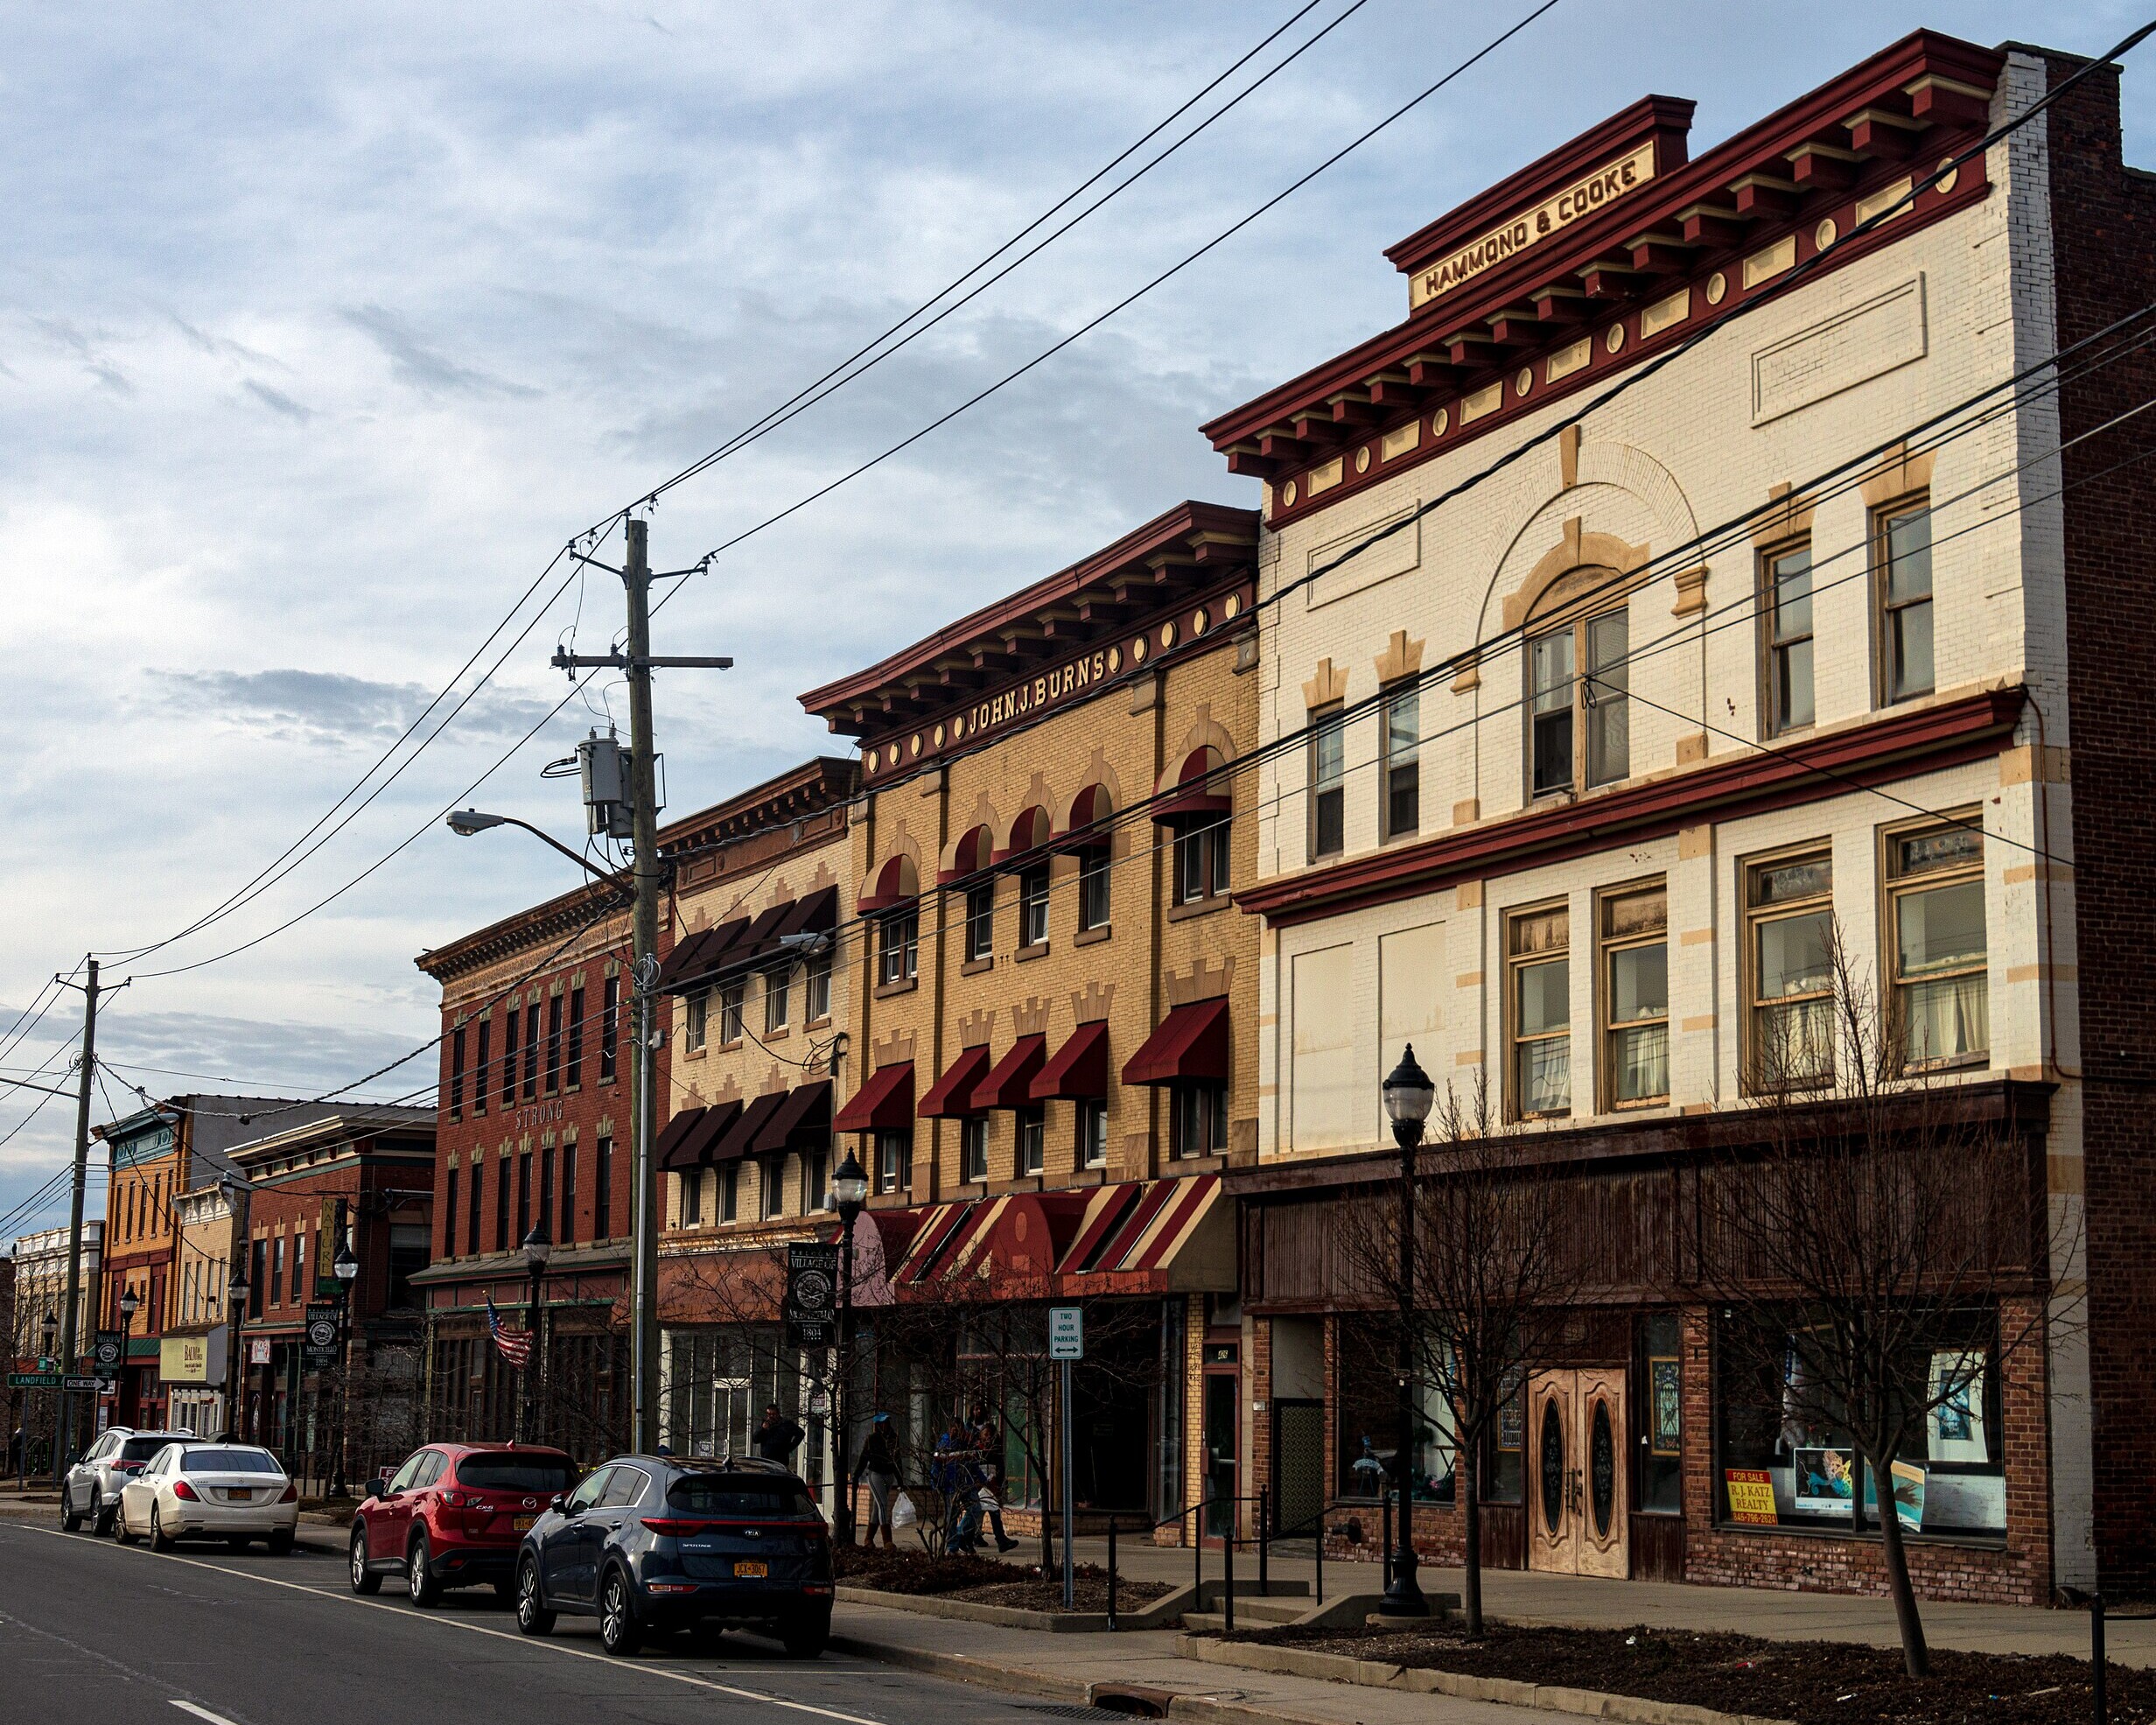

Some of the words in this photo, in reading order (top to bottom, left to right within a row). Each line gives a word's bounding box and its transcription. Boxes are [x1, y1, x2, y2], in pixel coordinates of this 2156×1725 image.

[1426, 222, 1528, 296] HAMMOND
[1536, 210, 1550, 234] &
[1558, 161, 1636, 221] COOKE
[515, 1100, 563, 1130] STRONG
[321, 1202, 333, 1273] NATURE
[791, 1259, 824, 1268] VILLAGE
[802, 1328, 822, 1337] 1804
[306, 1344, 338, 1353] MONTICELLO
[15, 1376, 57, 1385] LANDFIELD
[1732, 1472, 1746, 1481] FOR
[1746, 1473, 1765, 1482] SALE
[1746, 1486, 1770, 1497] KATZ
[1736, 1498, 1768, 1511] REALTY
